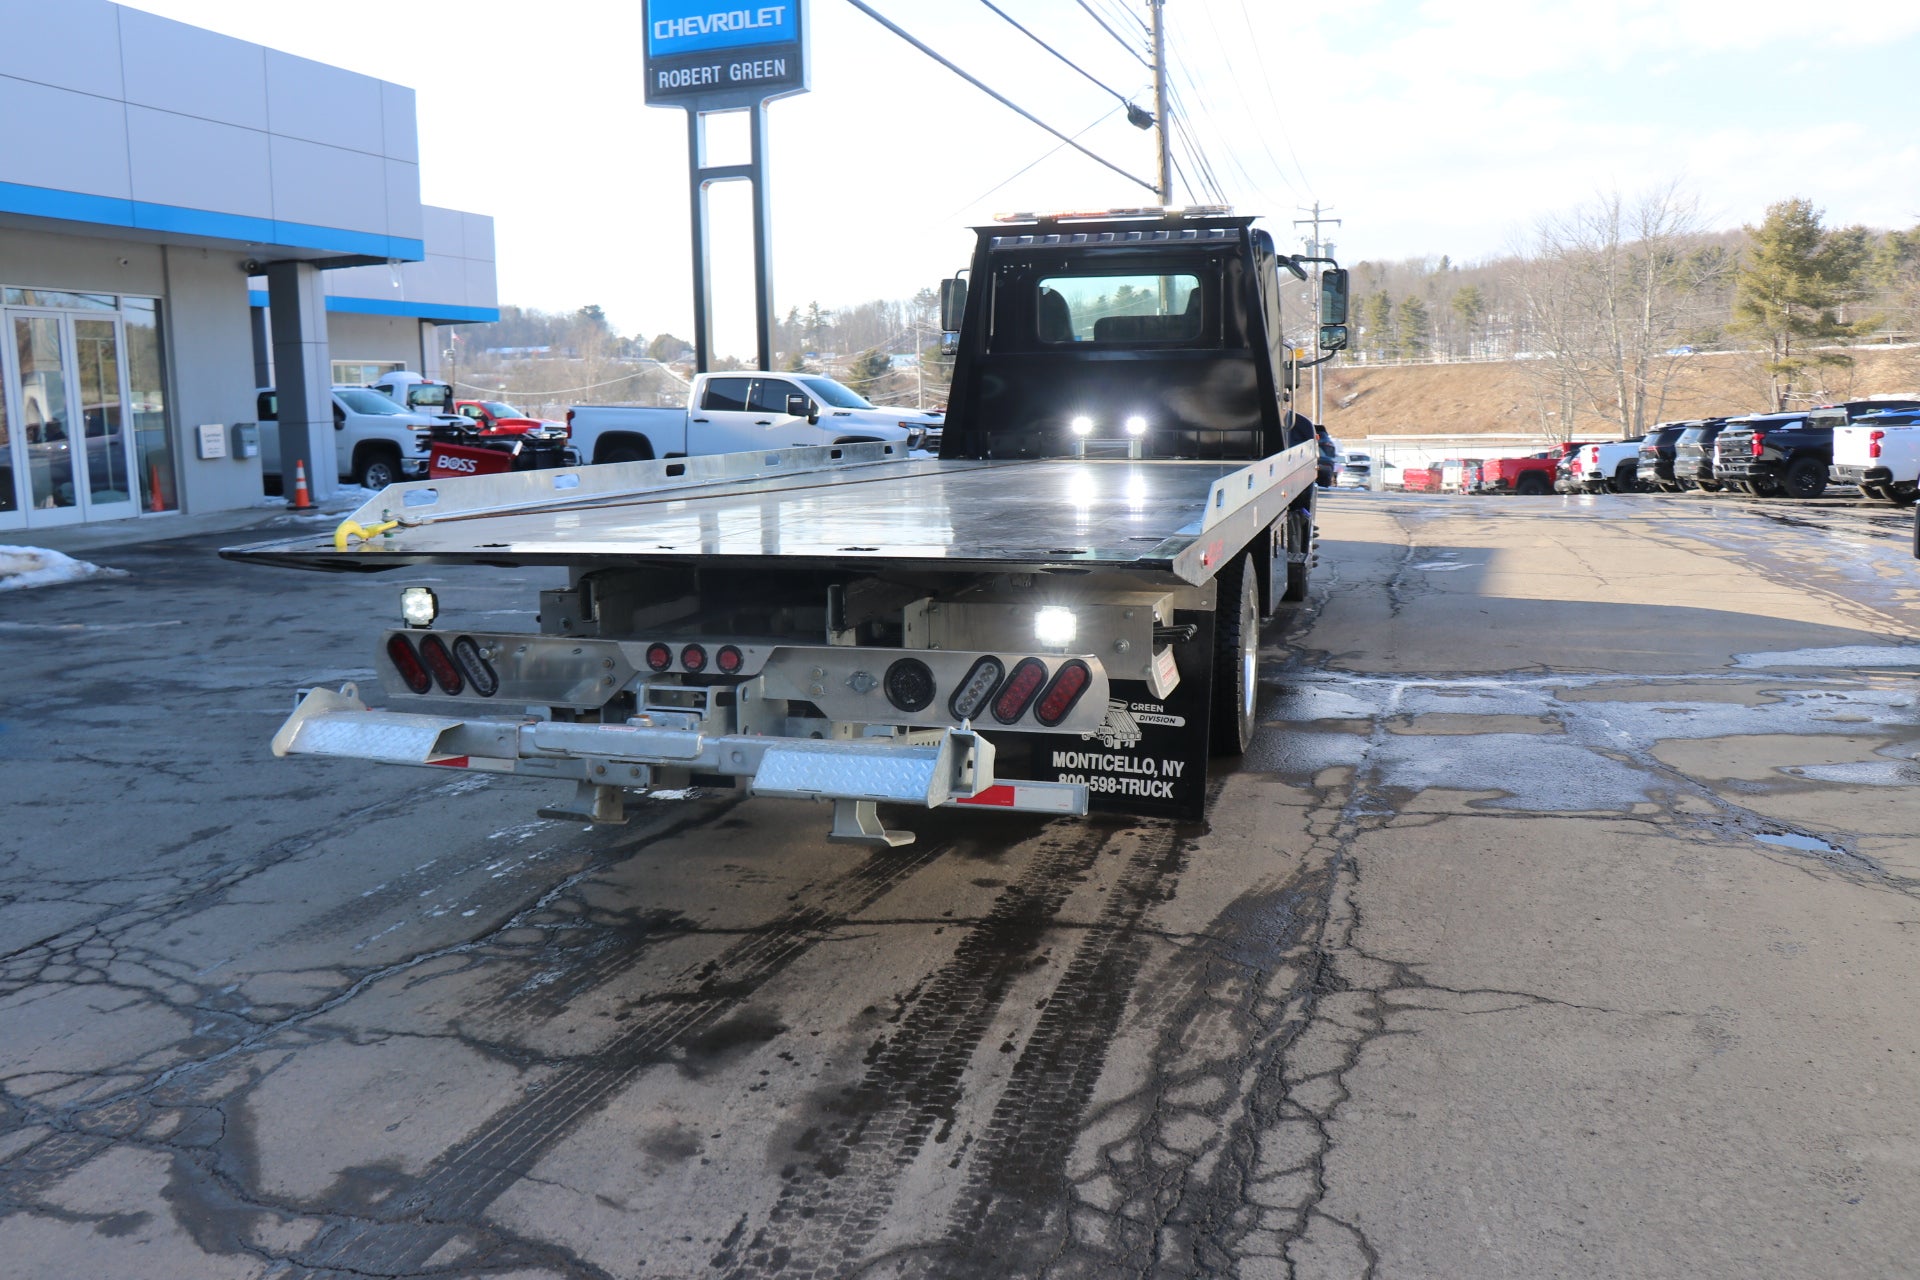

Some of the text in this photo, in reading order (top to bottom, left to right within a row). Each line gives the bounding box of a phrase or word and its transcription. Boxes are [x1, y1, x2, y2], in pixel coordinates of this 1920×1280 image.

[654, 6, 786, 40] CHEVROLET
[659, 58, 786, 88] ROBERT GREEN
[437, 455, 478, 473] BOSS
[1130, 702, 1164, 713] GREEN
[1139, 714, 1176, 724] DIVISION
[1052, 751, 1185, 777] MONTICELLO, NY
